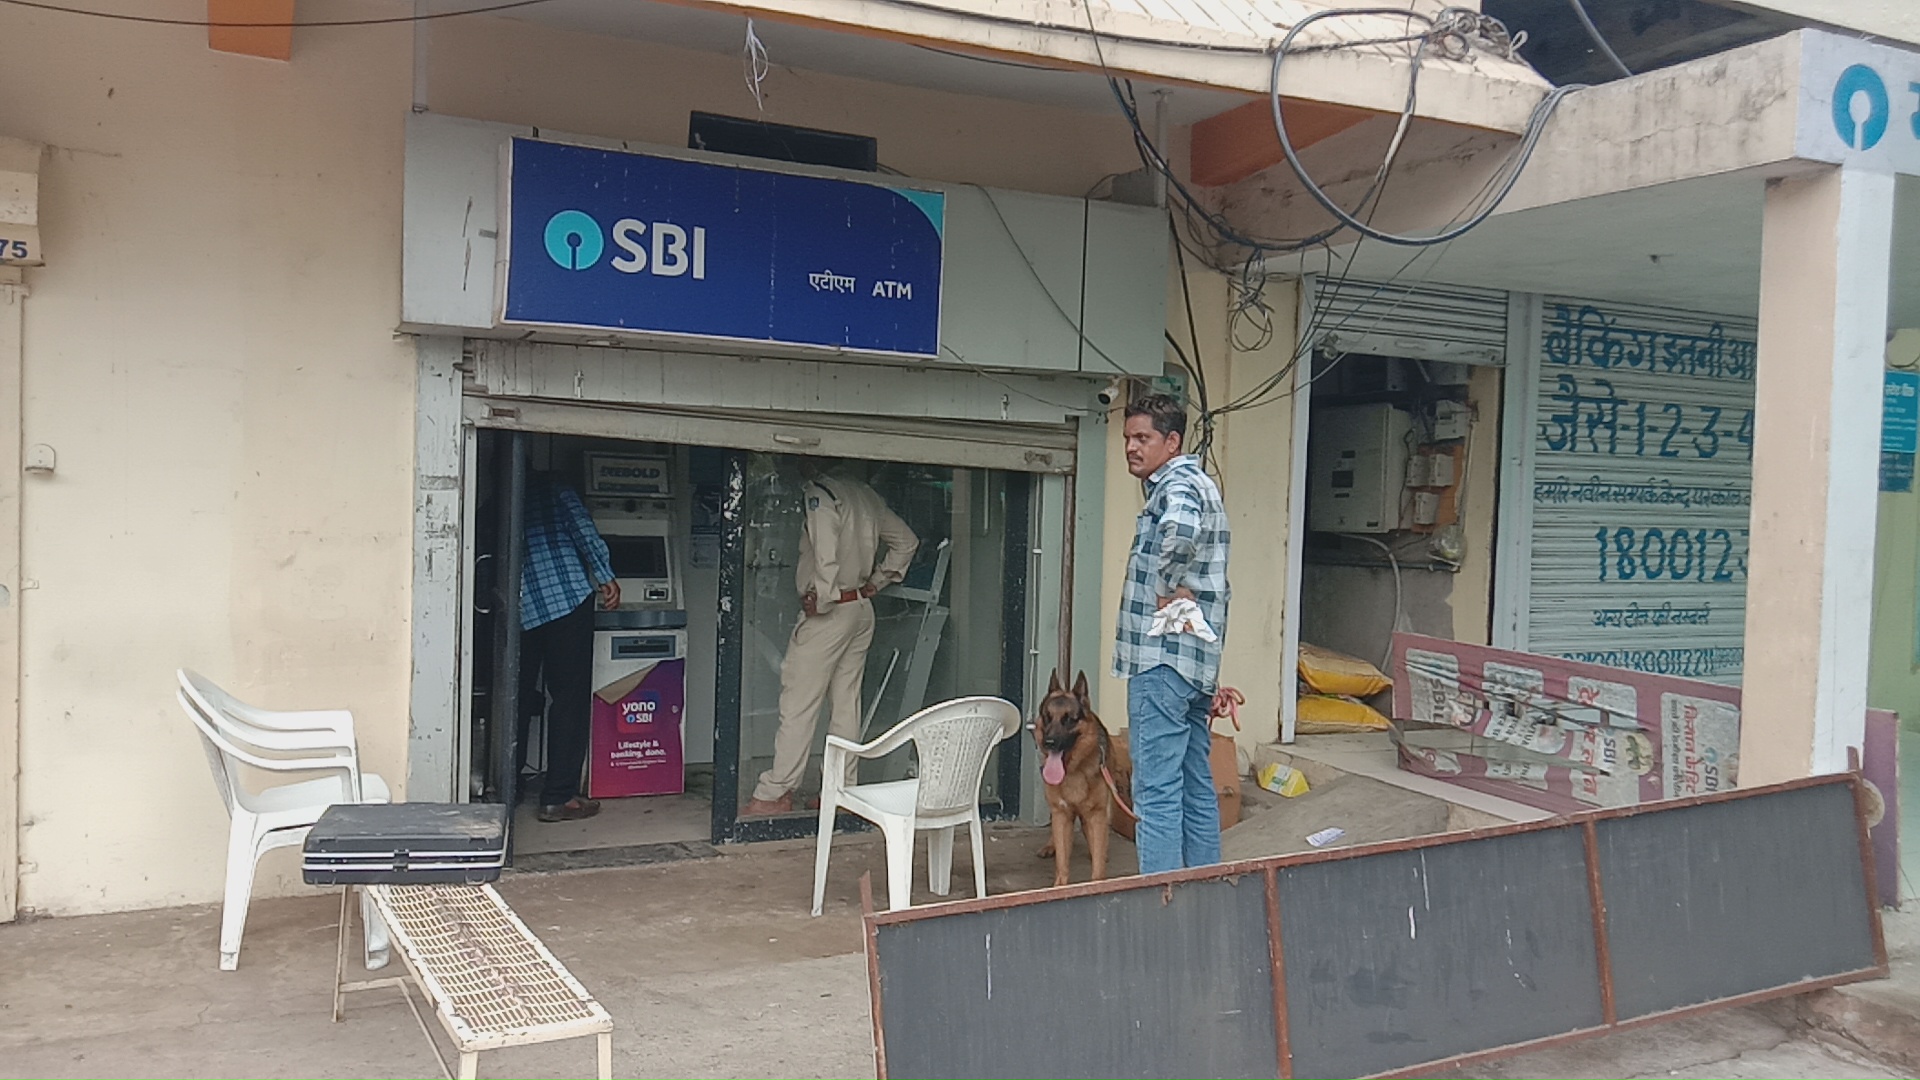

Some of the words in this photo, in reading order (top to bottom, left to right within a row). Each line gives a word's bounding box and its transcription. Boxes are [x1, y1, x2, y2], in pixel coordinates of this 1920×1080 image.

[611, 217, 706, 280] SBI
[809, 269, 855, 294] एटीएम
[872, 280, 913, 300] ATM
[621, 701, 656, 715] yono
[636, 713, 653, 723] SBI
[1604, 738, 1616, 764] SBI
[1705, 765, 1718, 792] SBI
